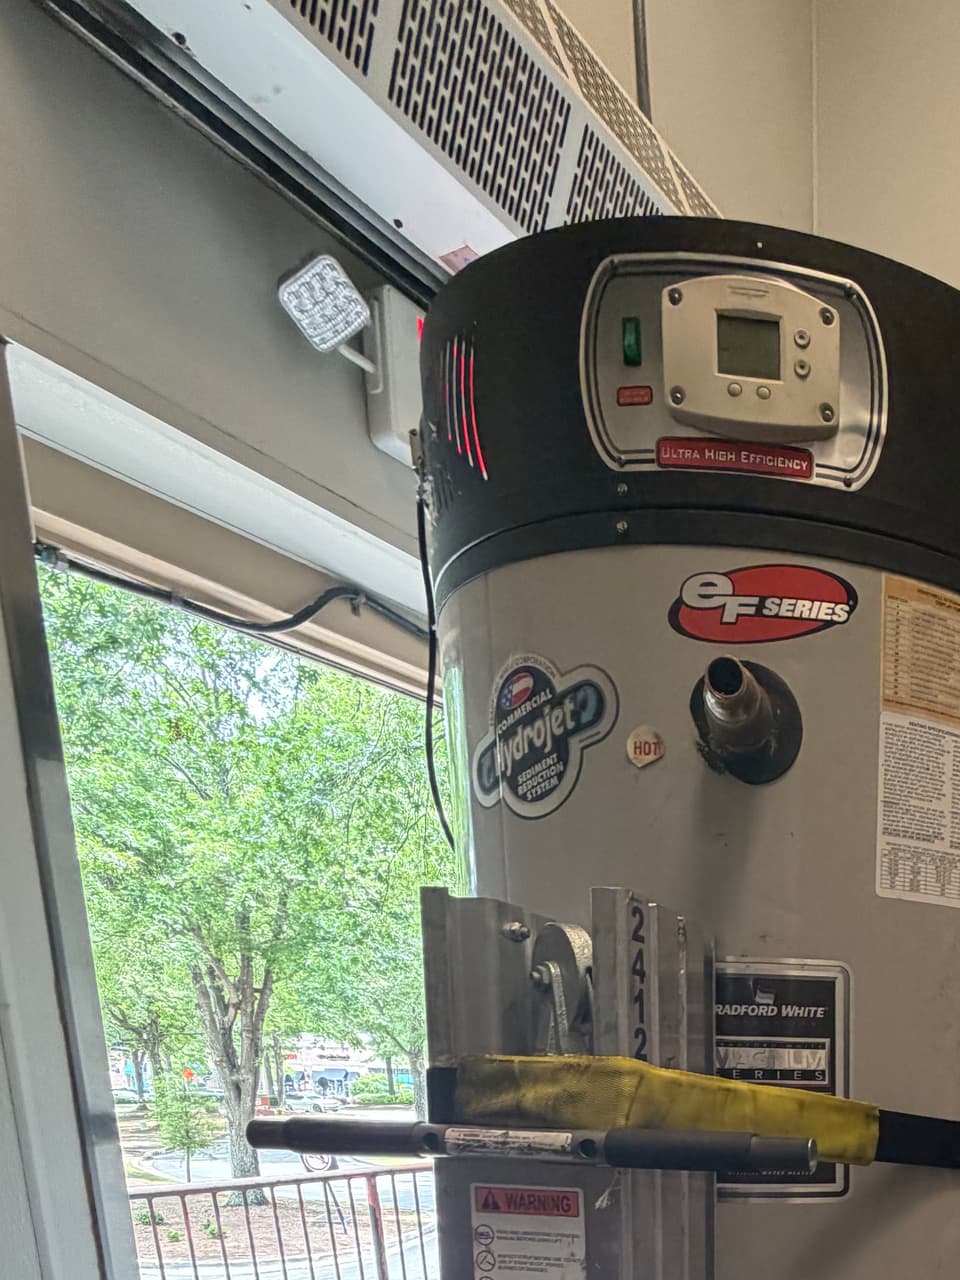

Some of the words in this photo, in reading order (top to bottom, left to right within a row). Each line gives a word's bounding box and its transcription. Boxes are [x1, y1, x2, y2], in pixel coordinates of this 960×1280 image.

[660, 445, 700, 460] ULTRA
[704, 448, 736, 462] HIGH
[740, 451, 809, 471] EFFICIENCY
[762, 597, 850, 622] SERIES
[497, 687, 553, 734] COMMERCIAL
[633, 740, 659, 756] HOT
[517, 752, 558, 785] SEDIMENT
[517, 761, 564, 796] REDUCTION
[526, 775, 560, 801] SYSTEM
[716, 1004, 778, 1016] RADFORD
[781, 1004, 826, 1018] WHITE
[732, 1069, 824, 1081] ERIES
[505, 1191, 571, 1213] WARNING
